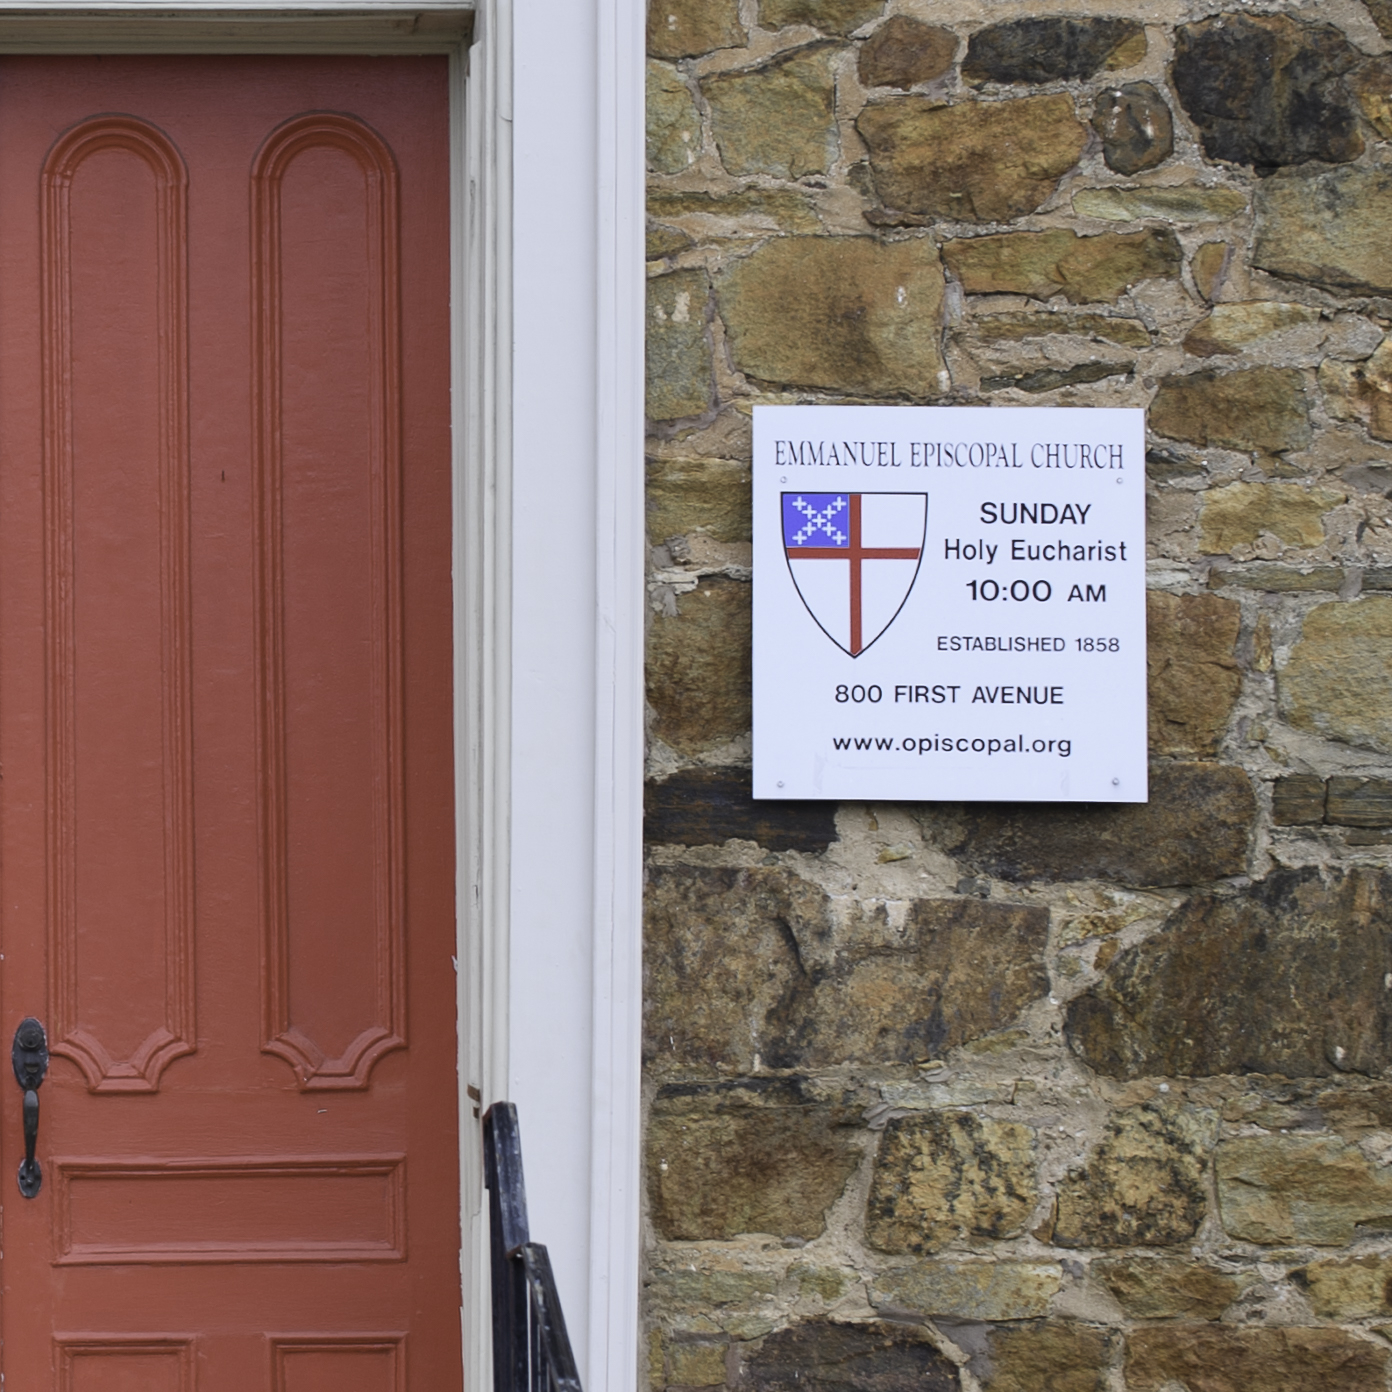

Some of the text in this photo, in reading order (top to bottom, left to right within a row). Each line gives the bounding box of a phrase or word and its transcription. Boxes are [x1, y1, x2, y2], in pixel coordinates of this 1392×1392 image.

[773, 440, 1124, 470] EMMANUEL EPISCOPAL CHURCH
[979, 501, 1092, 525] SUNDAY
[944, 538, 1128, 566] Holy Eucharist
[965, 578, 1107, 603] 10:00 AM
[937, 635, 1120, 653] ESTABLISHED 1858
[834, 684, 1064, 705] 800 FIRST AVENUE
[832, 733, 1072, 758] www.opiscopal.org
